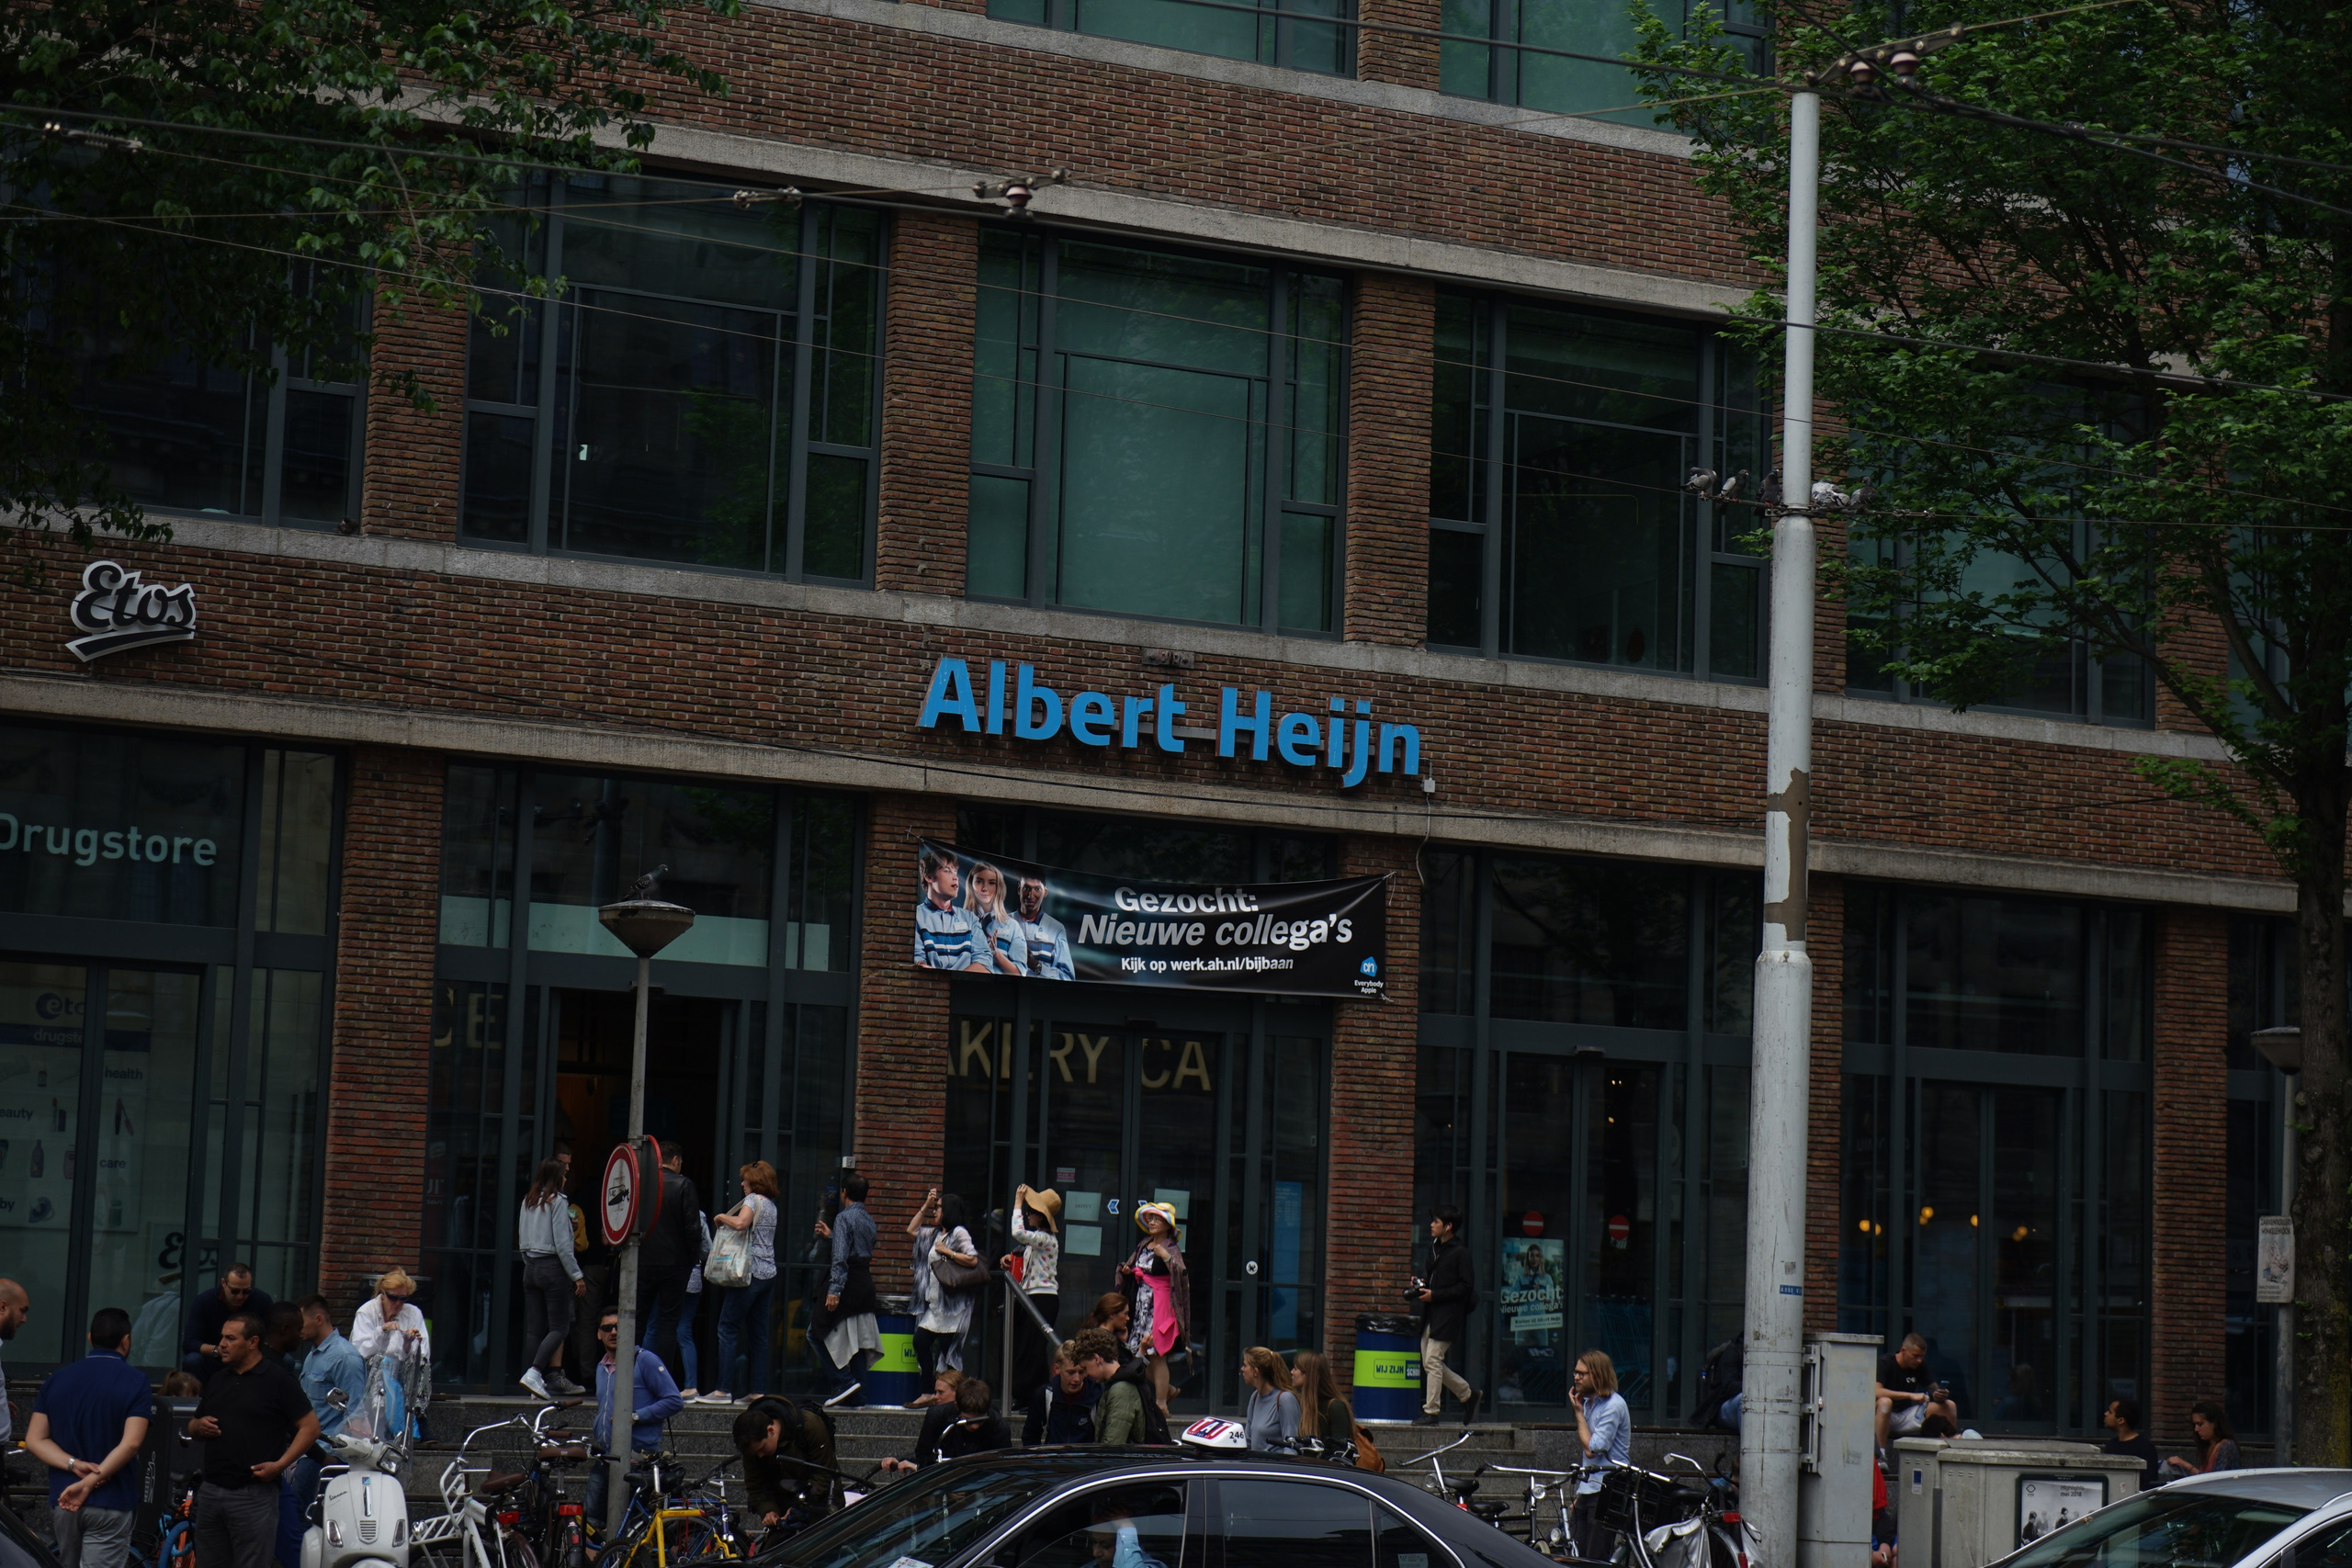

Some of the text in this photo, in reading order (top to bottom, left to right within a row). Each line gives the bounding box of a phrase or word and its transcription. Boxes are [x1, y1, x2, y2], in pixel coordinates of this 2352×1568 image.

[71, 561, 196, 632] Etos
[915, 656, 1420, 789] Albert Heijn
[0, 812, 217, 866] Drugstore
[1114, 886, 1260, 913] Gezocht:
[1077, 913, 1353, 951] Nieuwe collega's
[1121, 956, 1294, 974] Kijk op werk.ah.nl/bijbaan
[1353, 979, 1384, 988] Everybody
[36, 993, 85, 1020] eto
[33, 1028, 84, 1045] drugsto
[947, 1020, 1110, 1084] KERY
[105, 1067, 143, 1080] health
[0, 1108, 33, 1121] eauty
[99, 1157, 127, 1168] care
[0, 1197, 15, 1212] by
[1375, 1364, 1388, 1373] WIJ
[1389, 1365, 1404, 1374] ZIJN
[1228, 1431, 1244, 1439] 246
